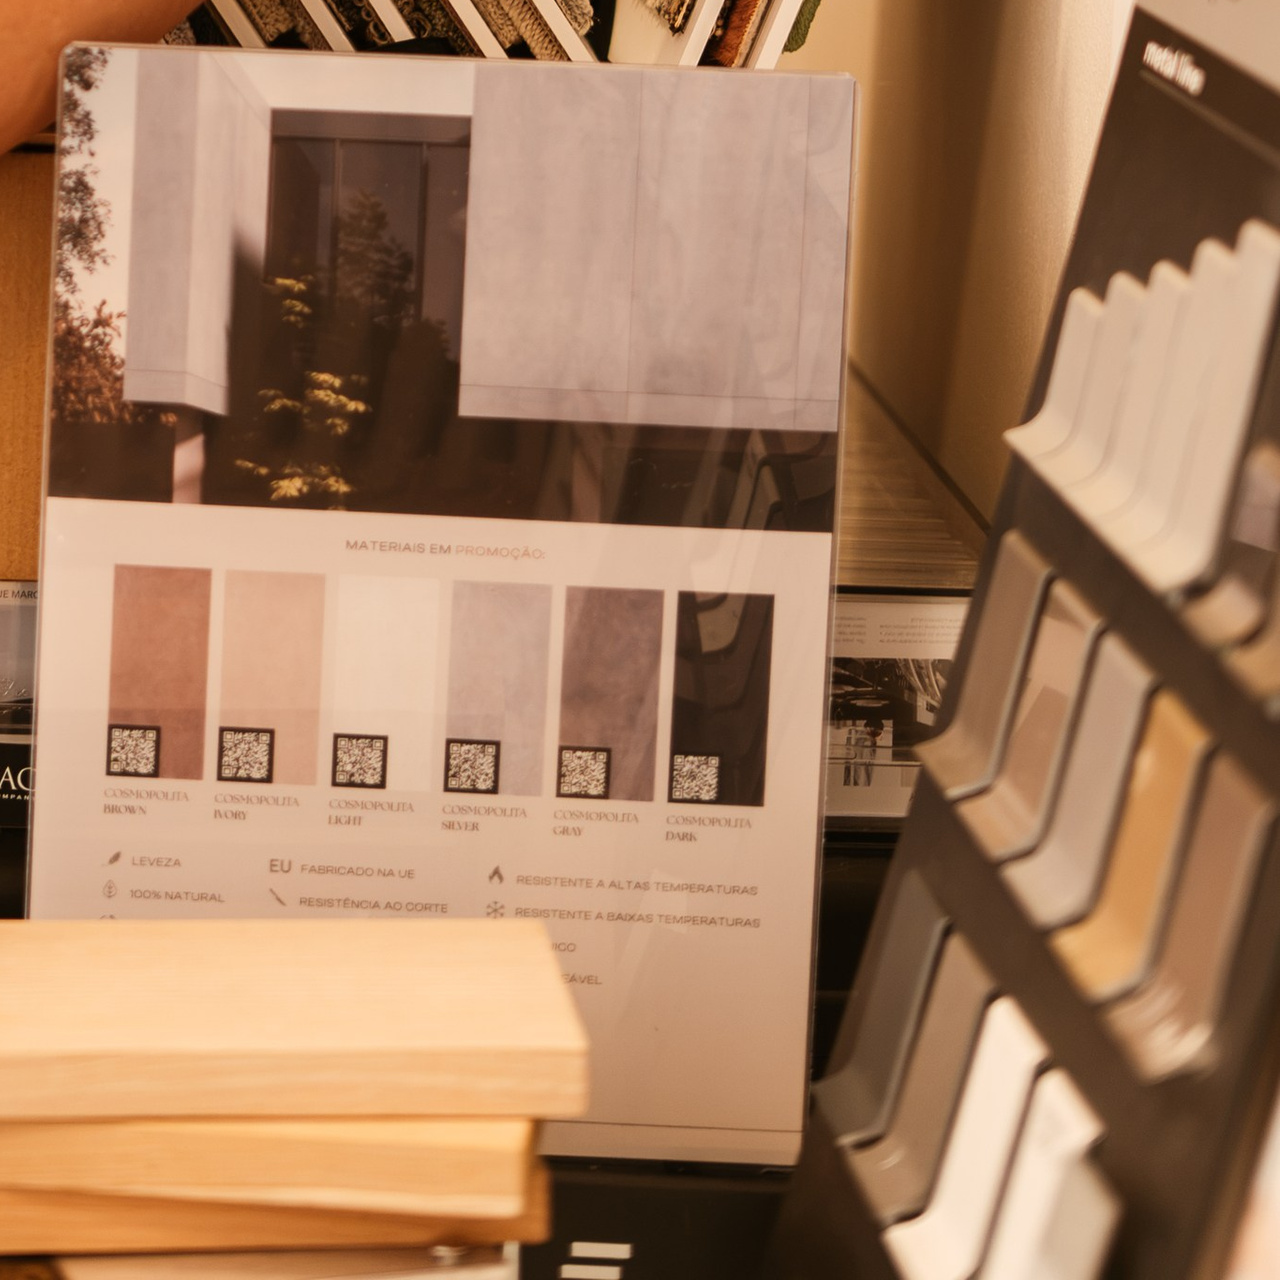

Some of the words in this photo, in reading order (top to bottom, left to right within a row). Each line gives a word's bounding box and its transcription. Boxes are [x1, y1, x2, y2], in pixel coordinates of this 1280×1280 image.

[345, 539, 425, 554] MATERIAIS
[429, 543, 451, 555] EM
[455, 544, 546, 560] PROMOÇÃO:
[104, 788, 189, 803] COSMOPOLITA
[214, 792, 300, 808] COSMOPOLITA
[103, 803, 148, 816] BROWN
[328, 798, 415, 813] COSMOPOLITA
[442, 804, 528, 819] COSMOPOLITA
[213, 809, 248, 821] IVORY
[327, 814, 363, 827] LIGHT
[553, 809, 639, 824] COSMOPOLITA
[666, 814, 752, 829] COSMOPOLITA
[441, 820, 480, 833] SILVER
[552, 825, 584, 838] GRAY
[665, 830, 698, 842] DARK
[131, 856, 182, 868] LEVEZA
[269, 858, 292, 874] EU
[300, 863, 374, 878] FABRICADO
[377, 867, 395, 878] NA
[398, 868, 416, 879] UE
[516, 875, 594, 889] RESISTENTE
[596, 879, 605, 889] A
[608, 879, 650, 891] ALTAS
[654, 881, 759, 896] TEMPERATURAS
[129, 888, 162, 900] 100%
[165, 890, 226, 903] NATURAL
[299, 896, 382, 910] RESISTÊNCIA
[383, 900, 403, 912] AO
[405, 901, 448, 913] CORTE
[514, 907, 593, 921] RESISTENTE
[595, 911, 604, 921] A
[606, 911, 654, 924] BAIXAS
[657, 913, 761, 929] TEMPERATURAS
